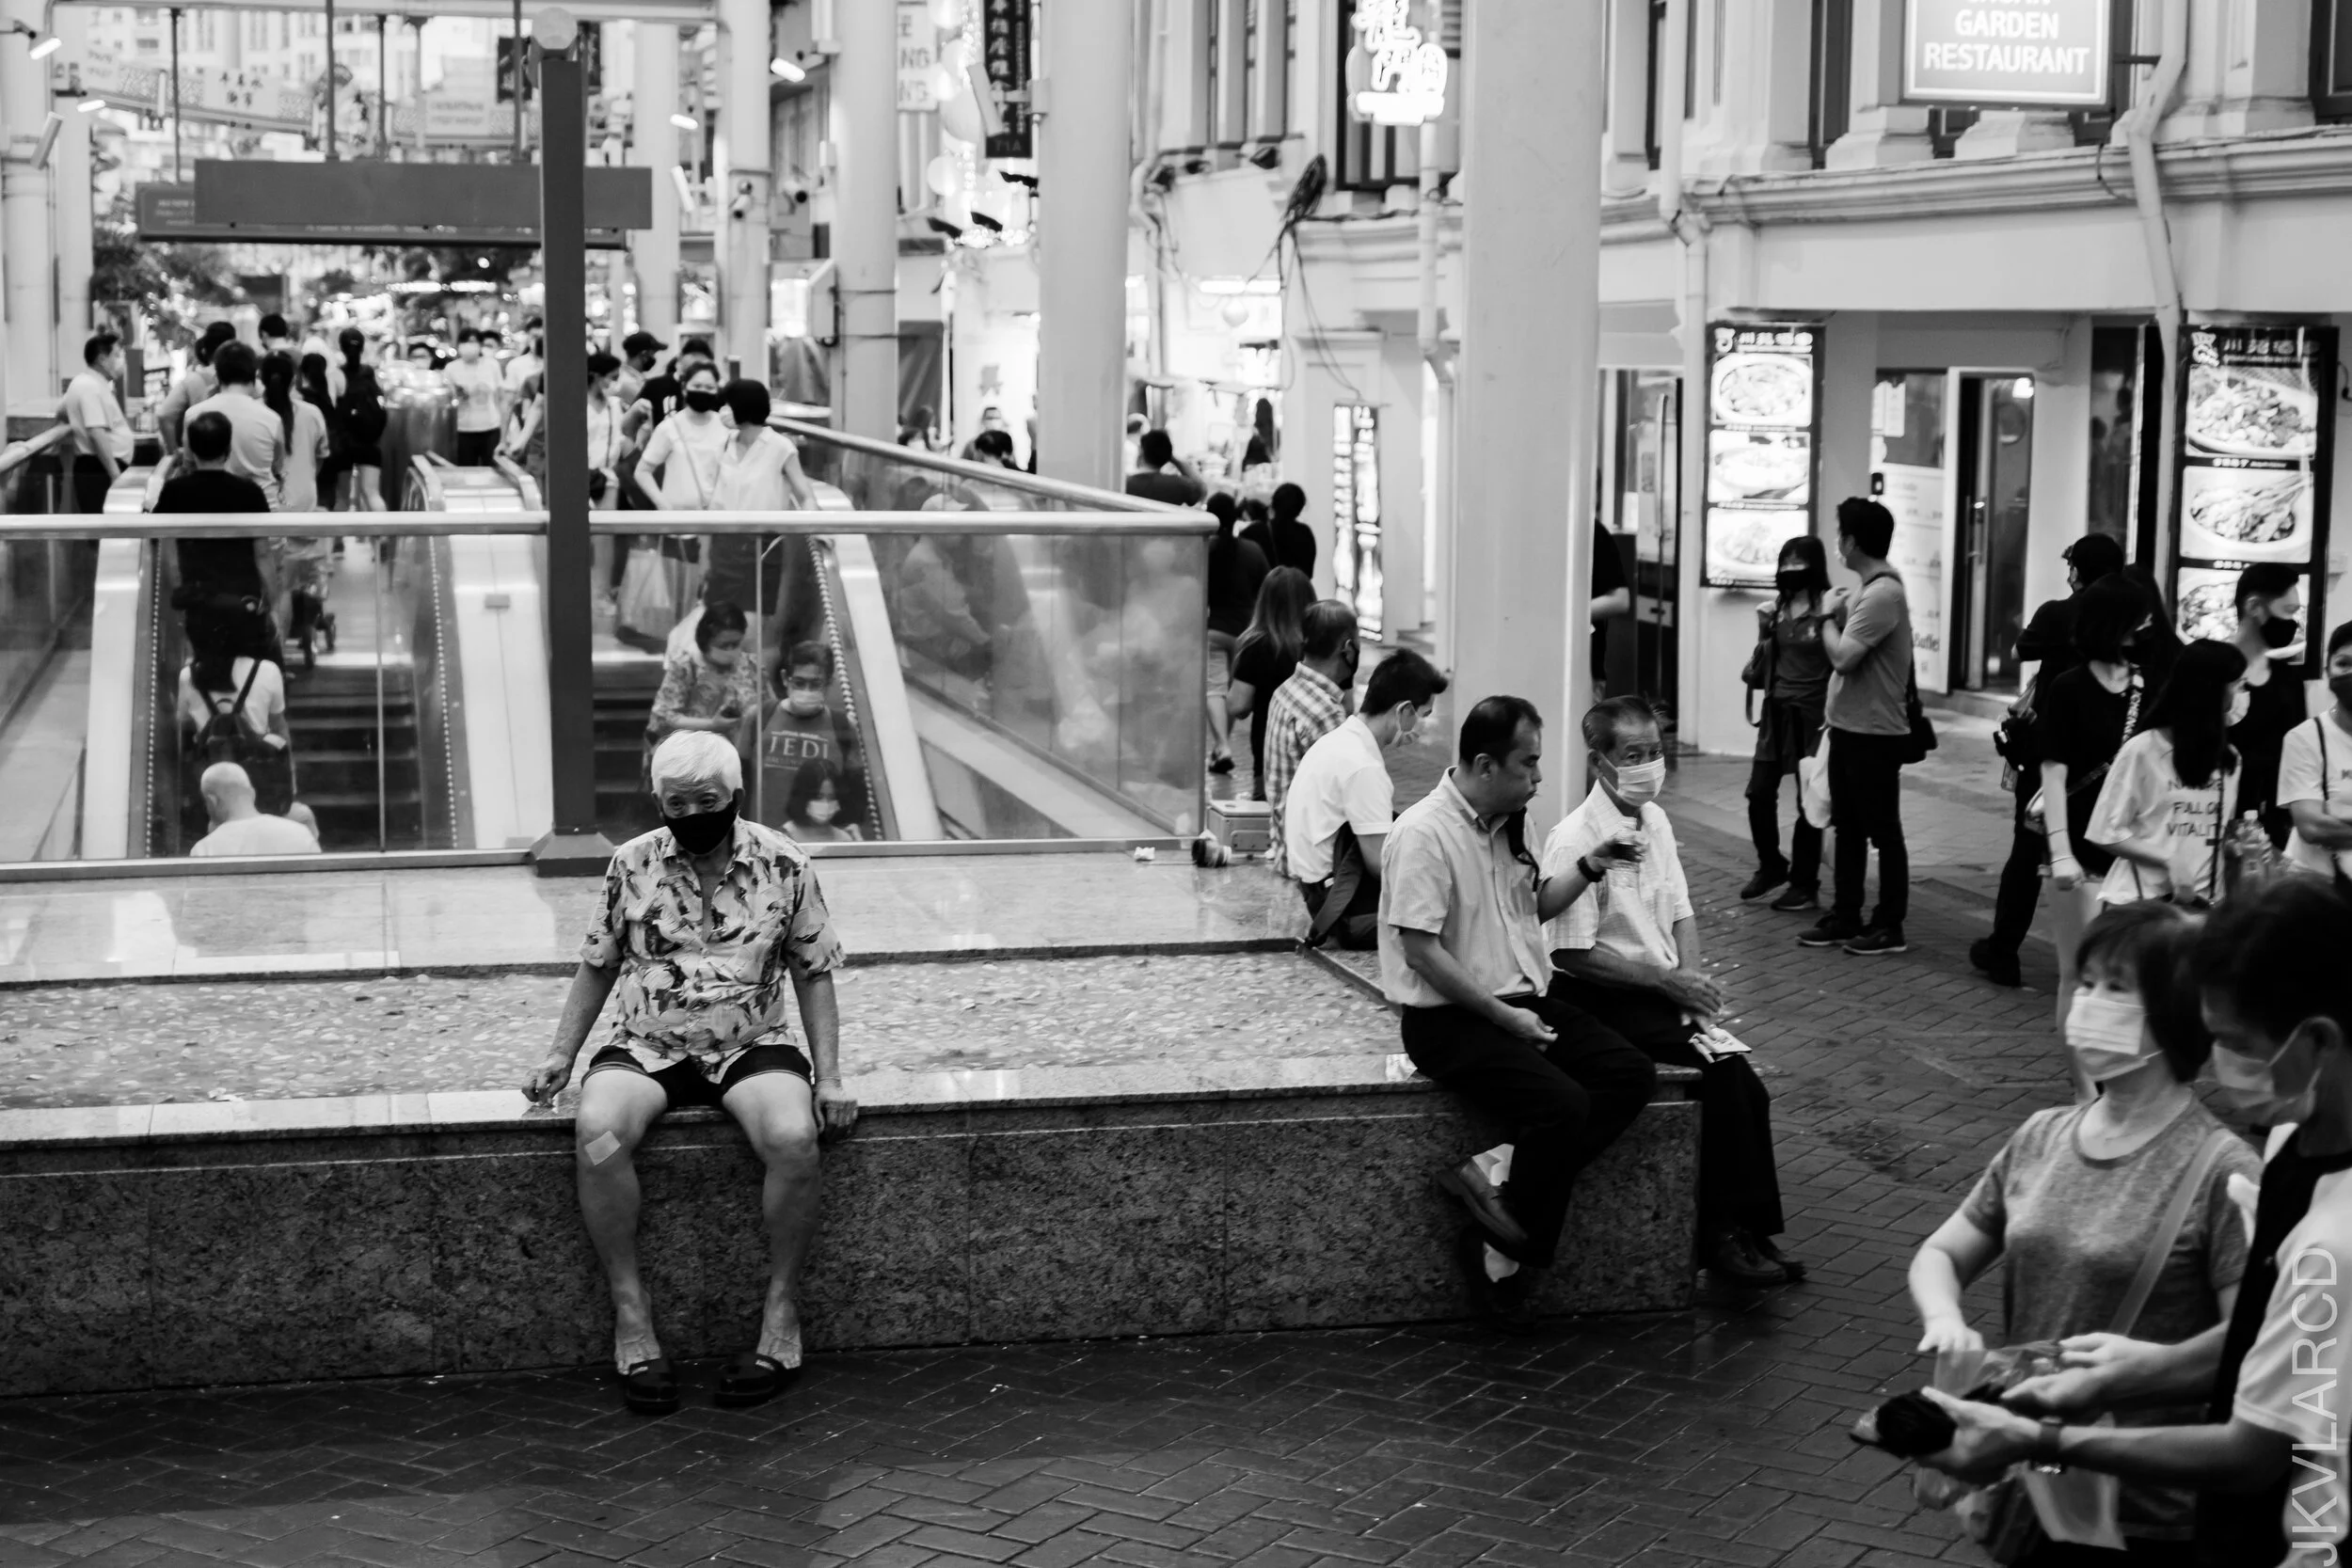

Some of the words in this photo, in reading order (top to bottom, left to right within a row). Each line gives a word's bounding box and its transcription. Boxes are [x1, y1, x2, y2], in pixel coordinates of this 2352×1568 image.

[1954, 8, 2059, 40] GARDEN
[1923, 42, 2090, 74] RESTAURANT
[770, 736, 828, 760] JEDI
